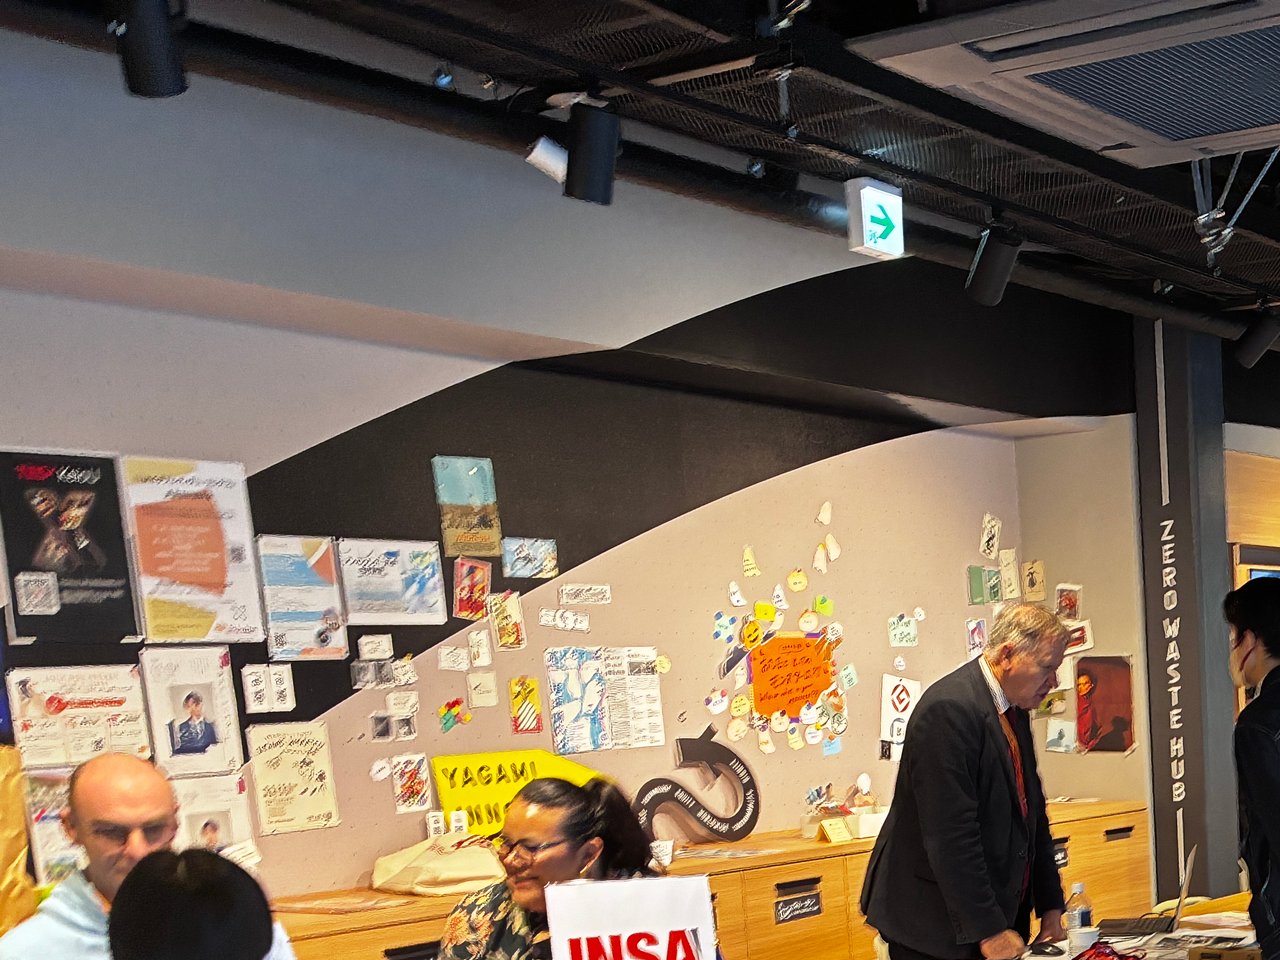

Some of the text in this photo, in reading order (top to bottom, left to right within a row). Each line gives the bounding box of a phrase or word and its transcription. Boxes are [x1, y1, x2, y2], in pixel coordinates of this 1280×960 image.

[1160, 519, 1187, 802] ZERO WASTE HUB
[442, 760, 538, 790] YAGAMI
